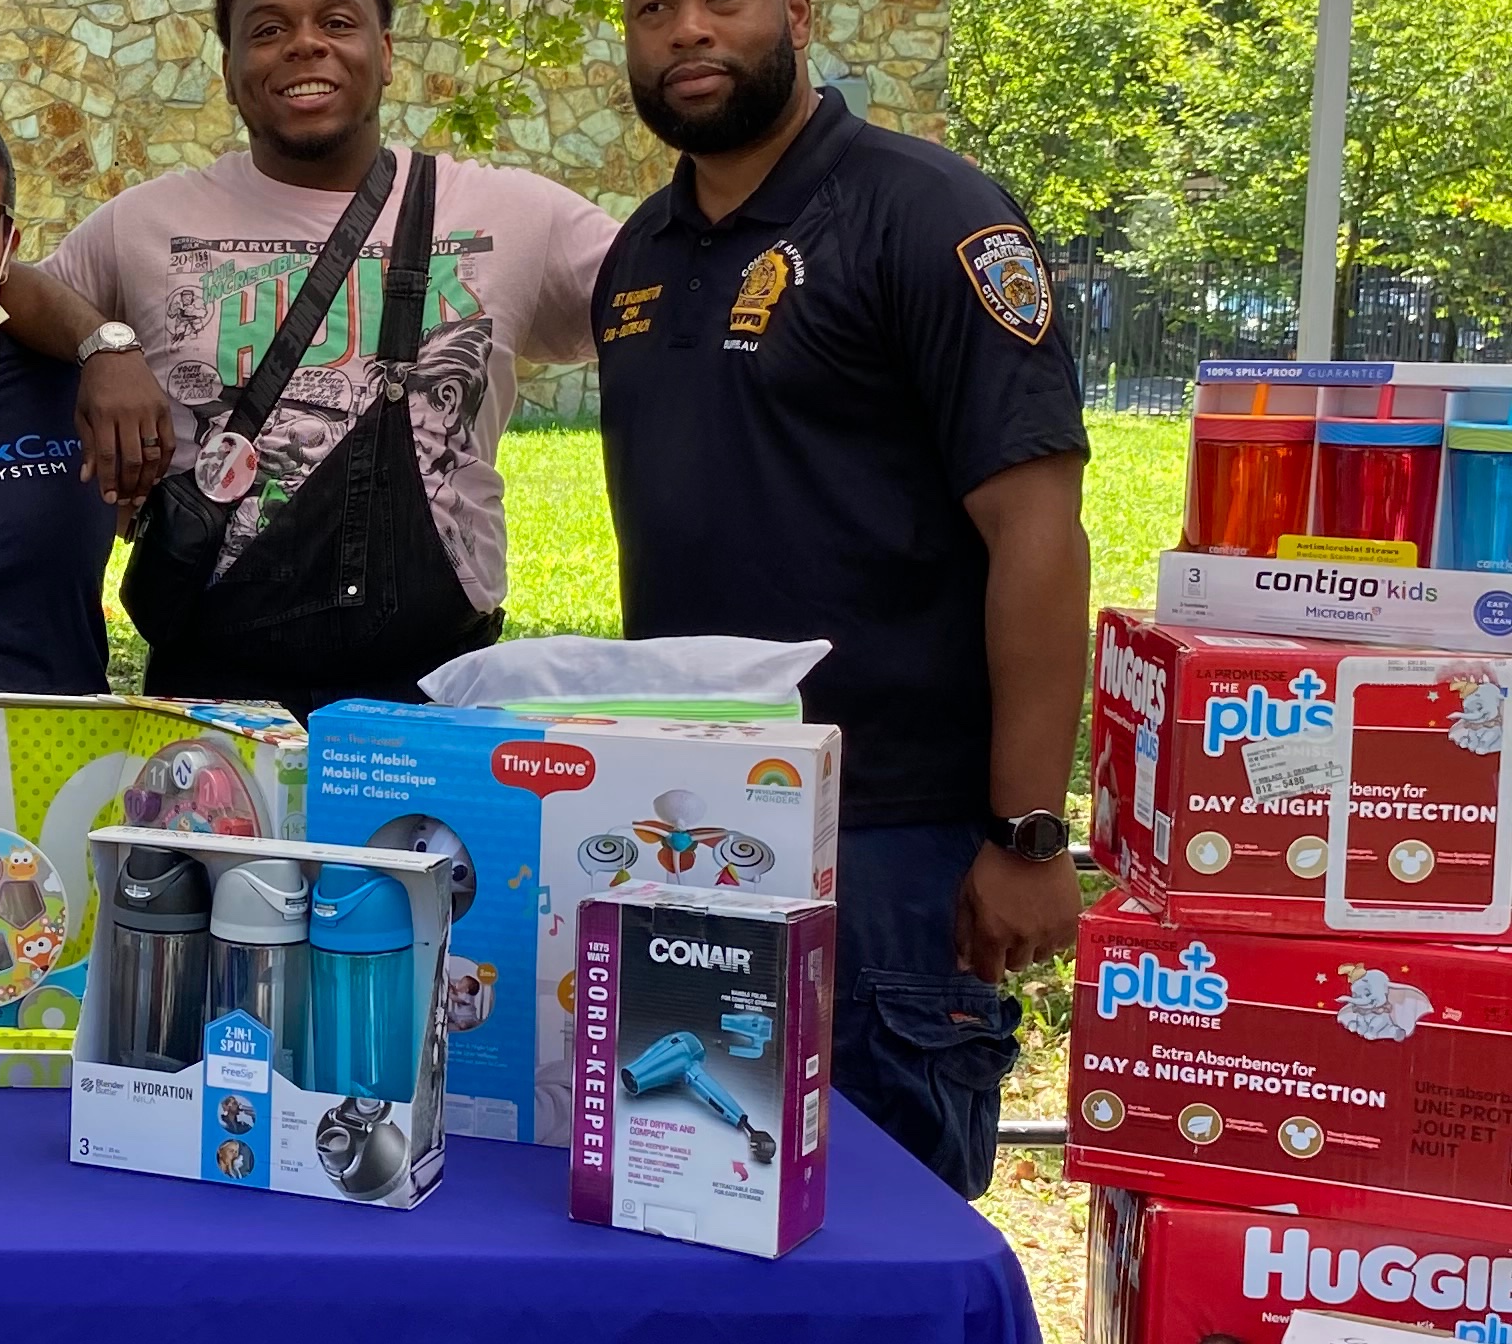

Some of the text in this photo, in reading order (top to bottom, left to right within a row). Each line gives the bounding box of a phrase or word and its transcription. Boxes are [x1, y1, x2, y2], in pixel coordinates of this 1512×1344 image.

[220, 241, 296, 253] MARVEL
[983, 233, 1021, 251] POLICE
[199, 259, 235, 287] THE
[784, 244, 805, 286] AFFAIRS
[202, 255, 313, 305] INCREDIBLE
[982, 284, 1021, 326] CITY OF
[1036, 300, 1048, 326] NEW
[1206, 368, 1384, 379] 100% SPILL-PROOF GUARANTEE
[1188, 568, 1201, 582] 3
[1256, 568, 1438, 602] contigo kids
[1099, 622, 1167, 725] HUGGIES
[1210, 682, 1239, 693] THE
[1209, 690, 1333, 752] plus
[322, 749, 417, 768] Classic Mobile
[501, 754, 587, 776] Tiny Love
[322, 767, 436, 787] Mobile Classique
[321, 783, 409, 801] Móvil Clásico
[755, 794, 800, 804] WONDERS
[1189, 795, 1236, 813] DAY
[1240, 796, 1257, 814] &
[1347, 801, 1497, 824] PROTECTION
[588, 942, 610, 953] 1875
[649, 937, 752, 974] CONAIR
[1103, 947, 1131, 960] THE
[587, 952, 610, 964] WATT
[1101, 958, 1224, 1016] plus
[1149, 1011, 1221, 1030] PROMISE
[225, 1026, 252, 1041] 2-IN-1
[220, 1039, 256, 1055] SPOUT
[583, 967, 609, 1169] CORD-KEEPER
[1152, 1045, 1316, 1078] Extra Absorbency for
[96, 1079, 193, 1101] Blender HYDRATION
[1084, 1054, 1386, 1108] DAY & NIGHT PROTECTION
[629, 1127, 665, 1139] COMPACT
[630, 1117, 696, 1134] FAST DRYING AND
[79, 1138, 90, 1156] 3
[1411, 1139, 1460, 1159] NUIT
